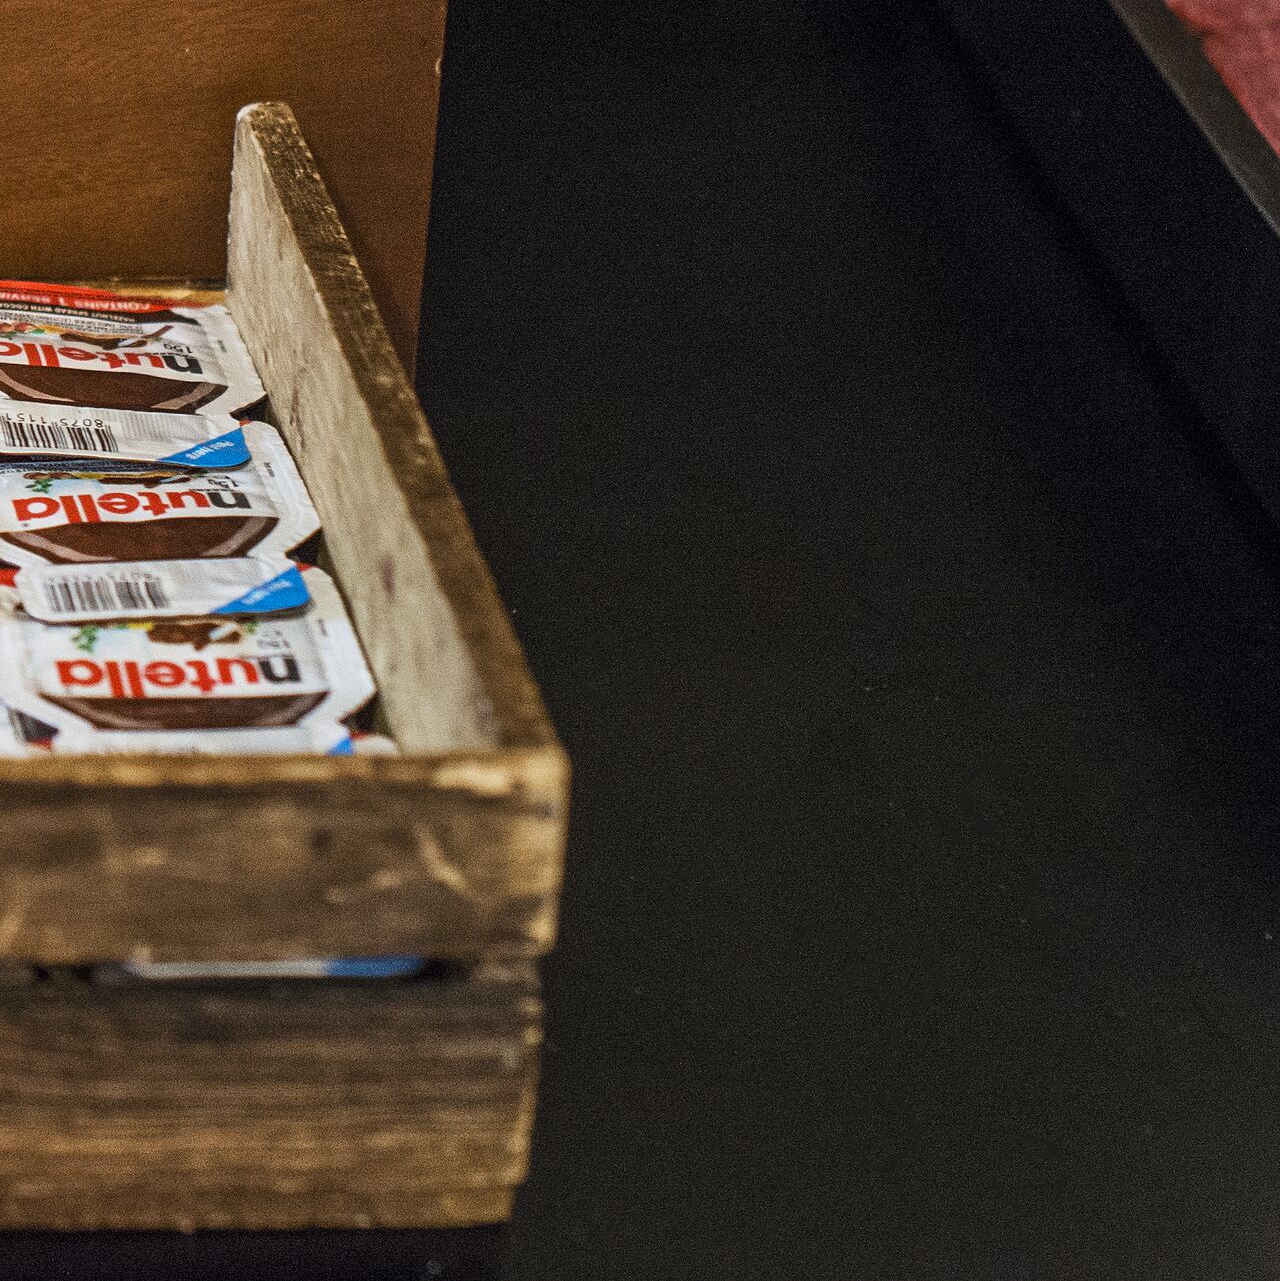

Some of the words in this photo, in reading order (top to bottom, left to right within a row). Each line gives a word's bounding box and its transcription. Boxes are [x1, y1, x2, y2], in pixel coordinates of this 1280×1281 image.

[4, 412, 46, 426] 1151
[60, 418, 103, 430] 8075
[12, 491, 252, 523] nutella
[55, 655, 301, 697] nutella
